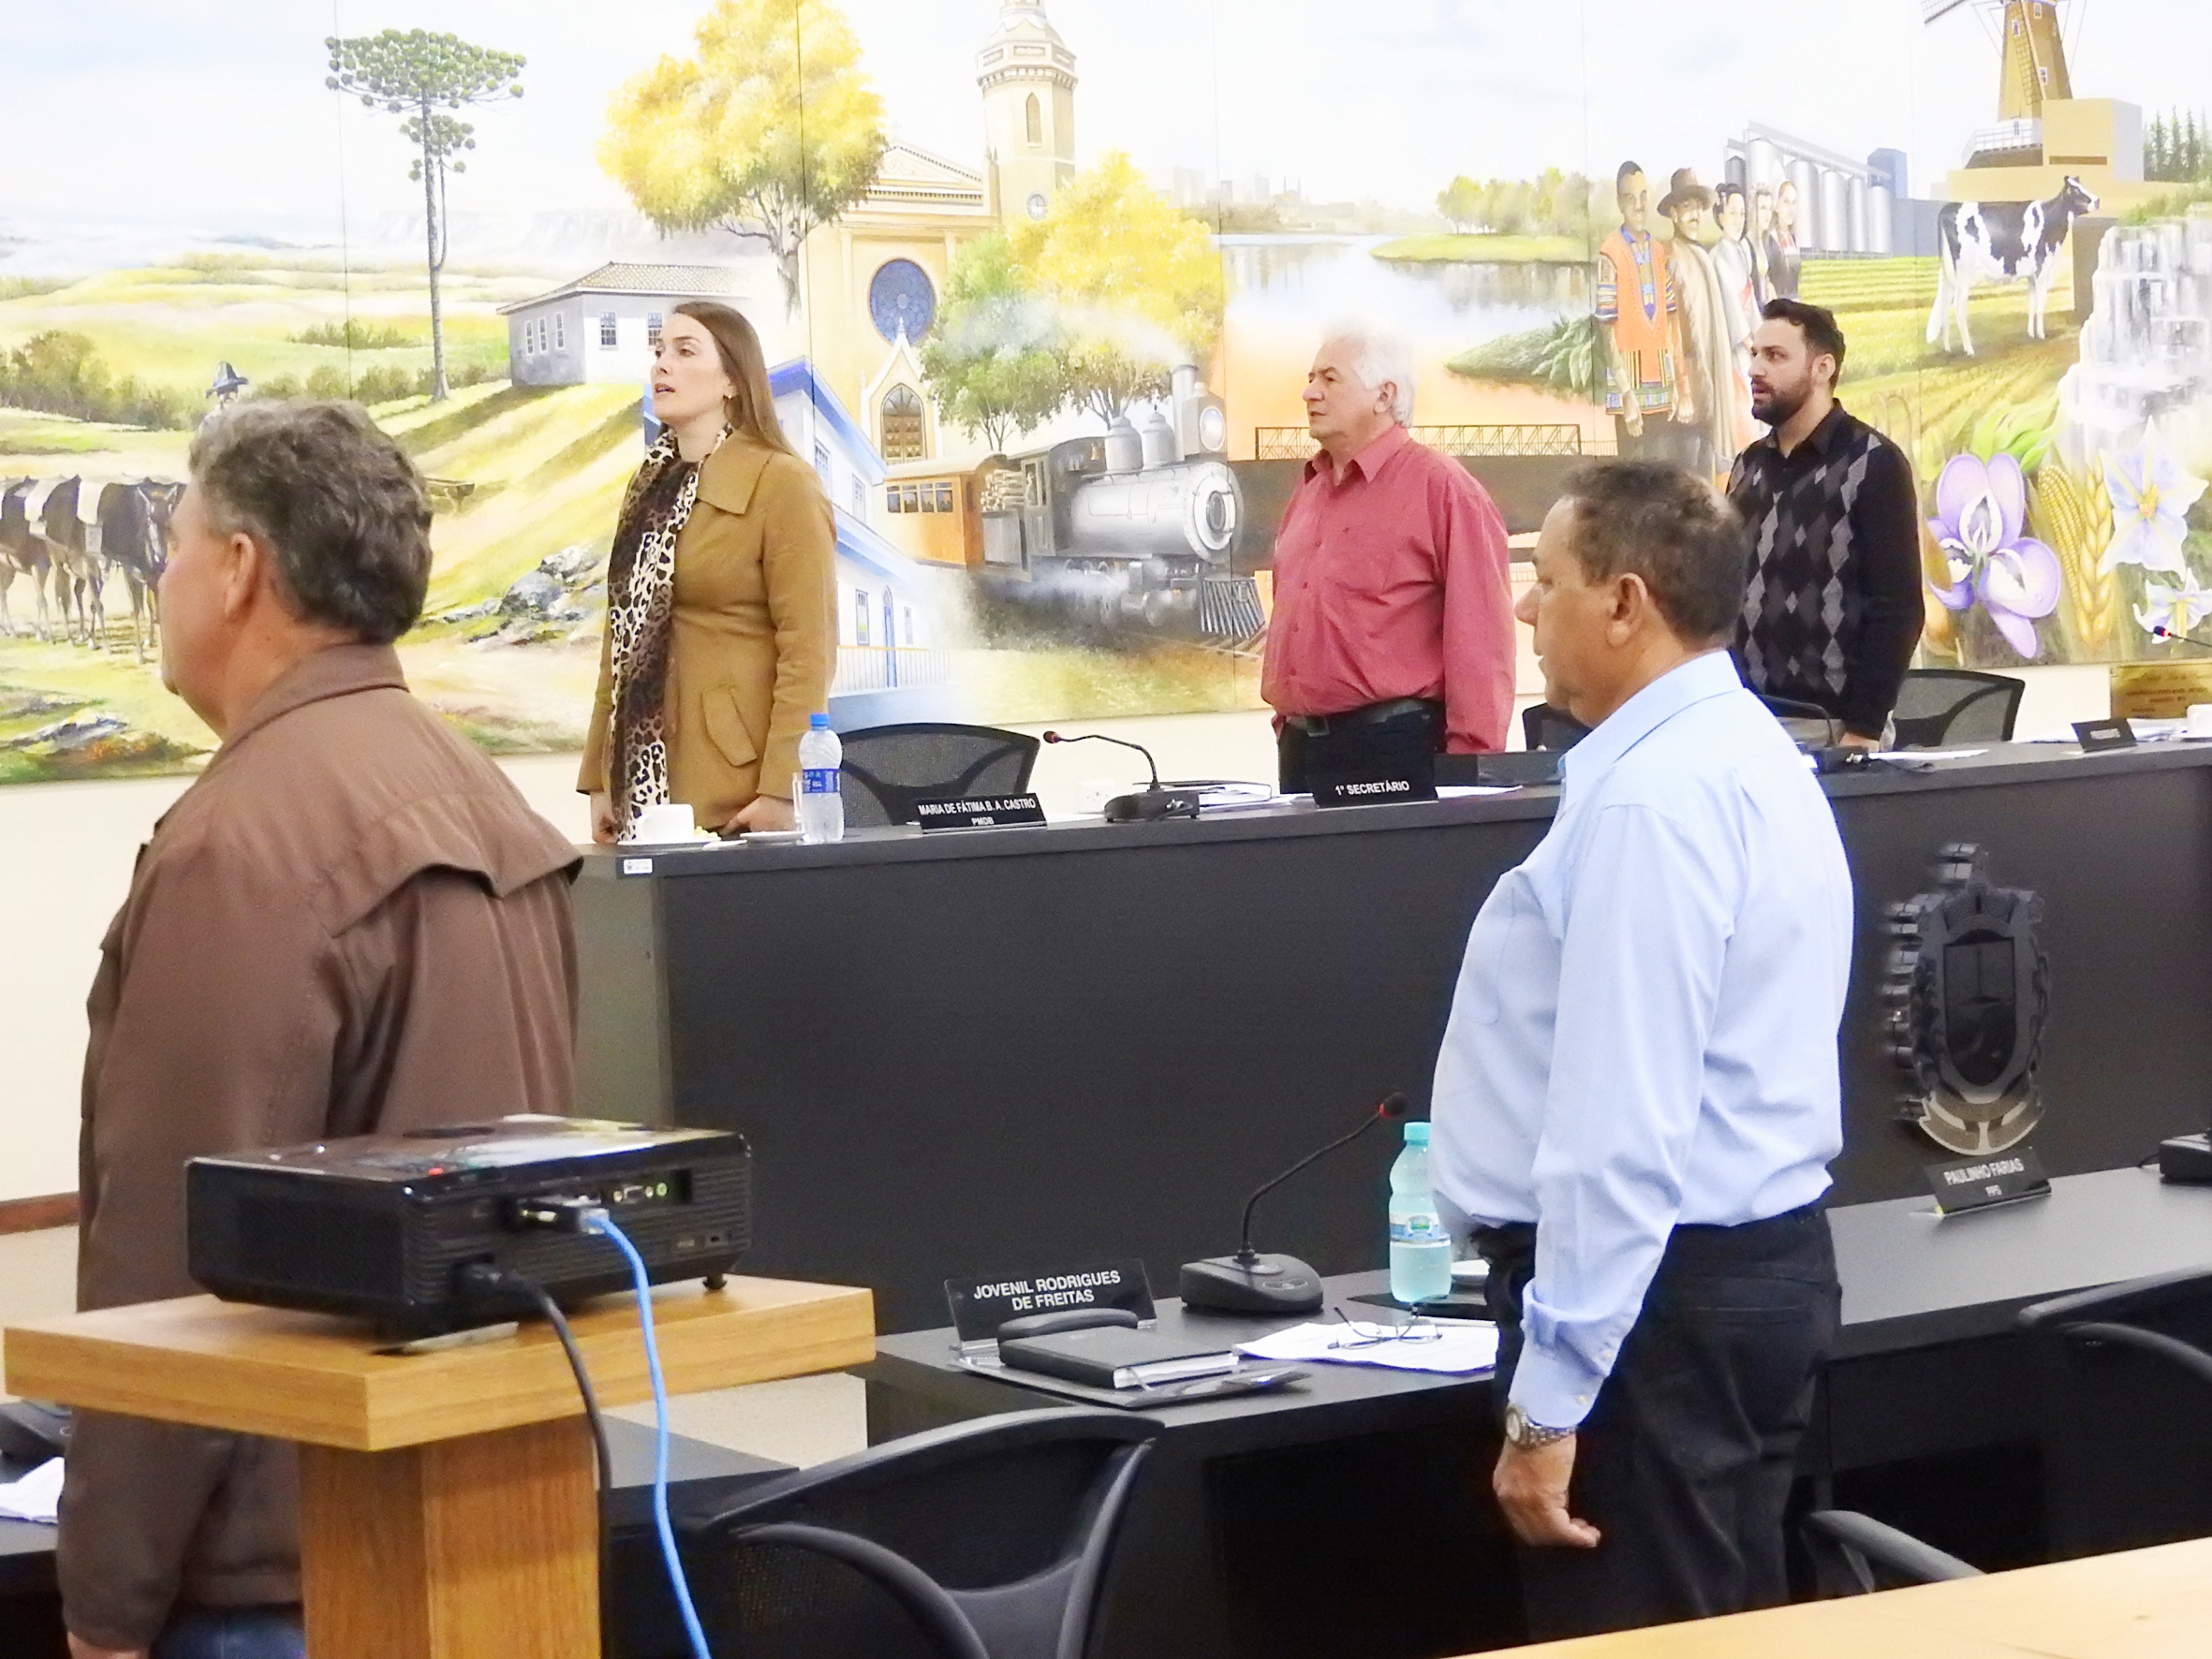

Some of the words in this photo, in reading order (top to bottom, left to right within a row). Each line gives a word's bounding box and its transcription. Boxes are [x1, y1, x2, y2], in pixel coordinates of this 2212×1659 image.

[1347, 780, 1409, 795] SECRETÁRIO
[918, 803, 944, 815] MARIA
[943, 802, 957, 815] DE
[957, 800, 986, 814] FÁTIMA
[985, 800, 995, 811] B.
[995, 800, 1004, 811] A.
[1004, 798, 1037, 811] CASTRO
[971, 816, 995, 826] PMDB
[1943, 1164, 1991, 1185] PAULINHO
[1989, 1157, 2025, 1177] FARIAS
[973, 1279, 1034, 1299] JOVENIL
[1036, 1270, 1121, 1292] RODRIGUES
[1012, 1295, 1033, 1311] DE
[1036, 1288, 1095, 1309] FREITAS
